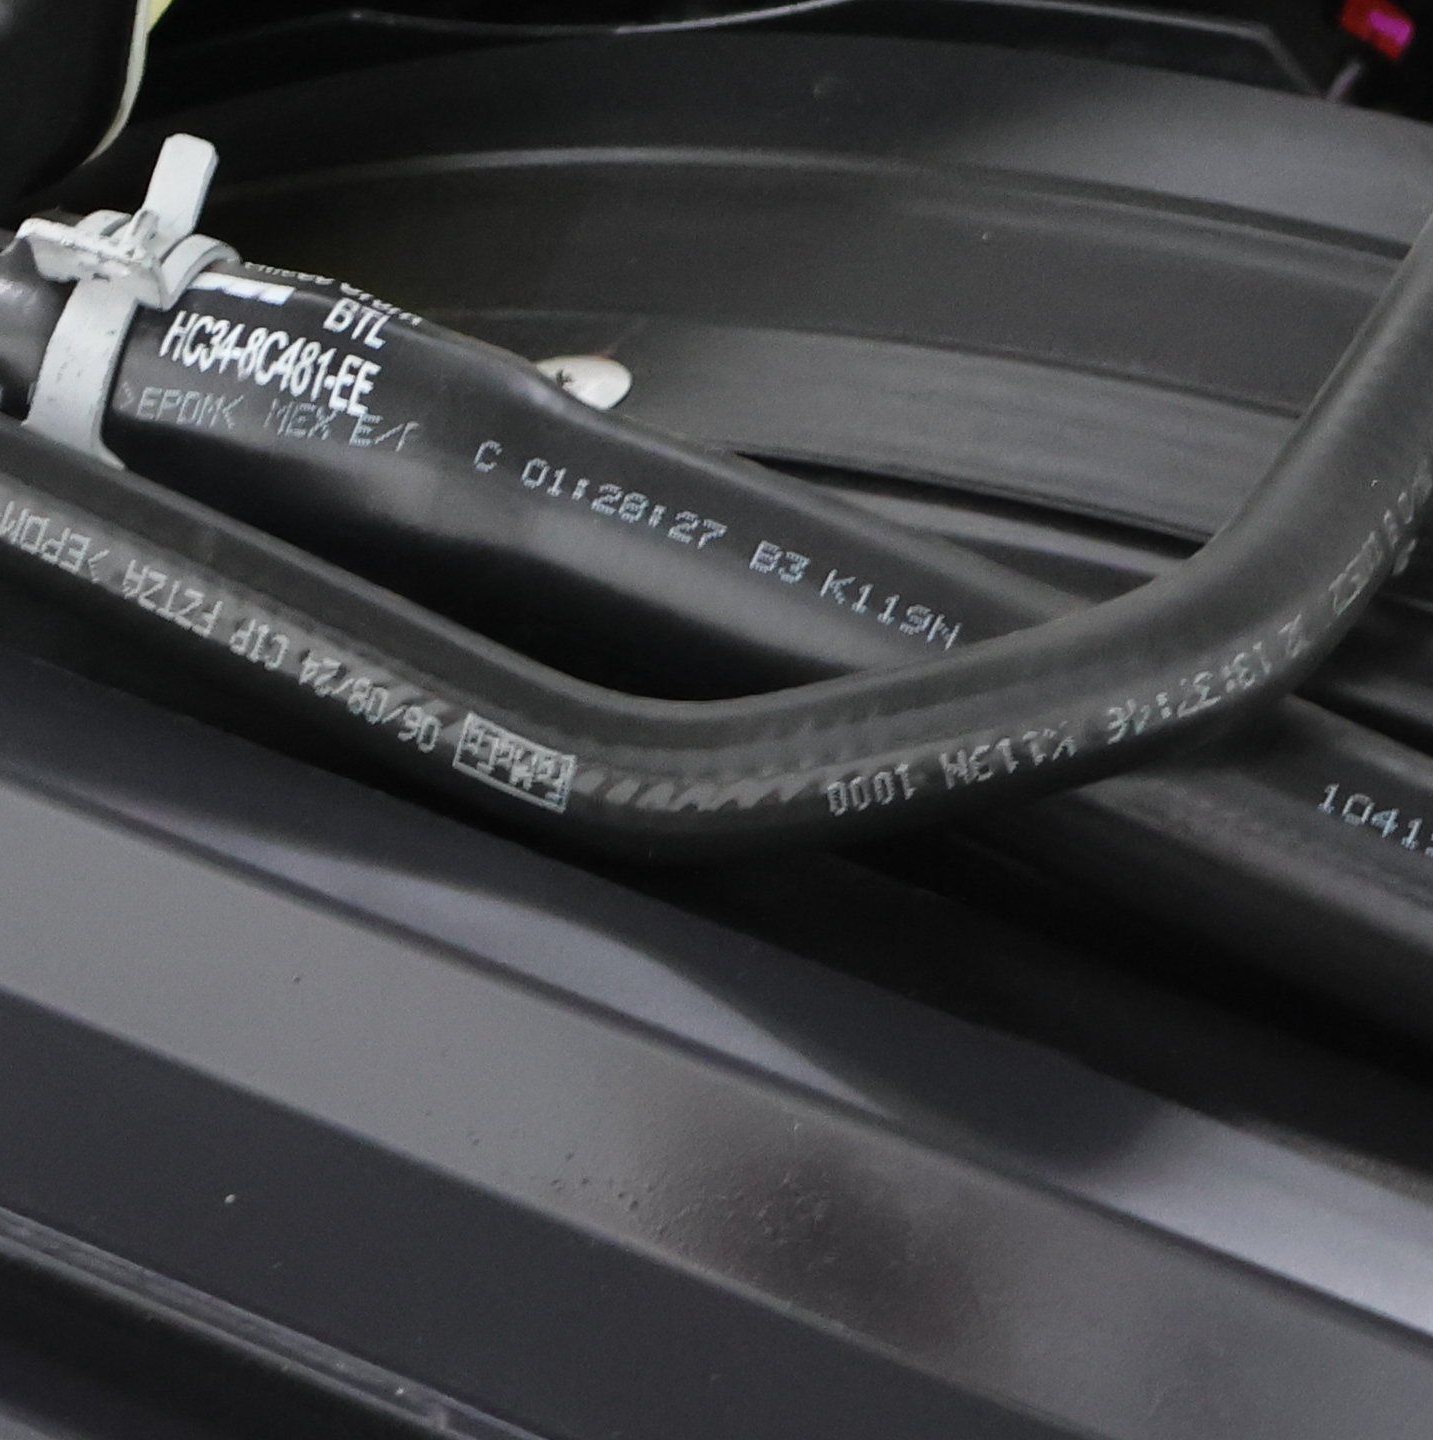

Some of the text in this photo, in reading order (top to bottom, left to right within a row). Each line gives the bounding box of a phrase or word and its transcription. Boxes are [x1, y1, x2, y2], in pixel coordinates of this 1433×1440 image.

[160, 310, 382, 418] HC34-8C481-EE
[323, 298, 387, 349] BTL
[269, 397, 335, 441] MEX
[474, 440, 503, 473] C
[749, 540, 810, 584] B3
[299, 649, 442, 753] 06/08/24
